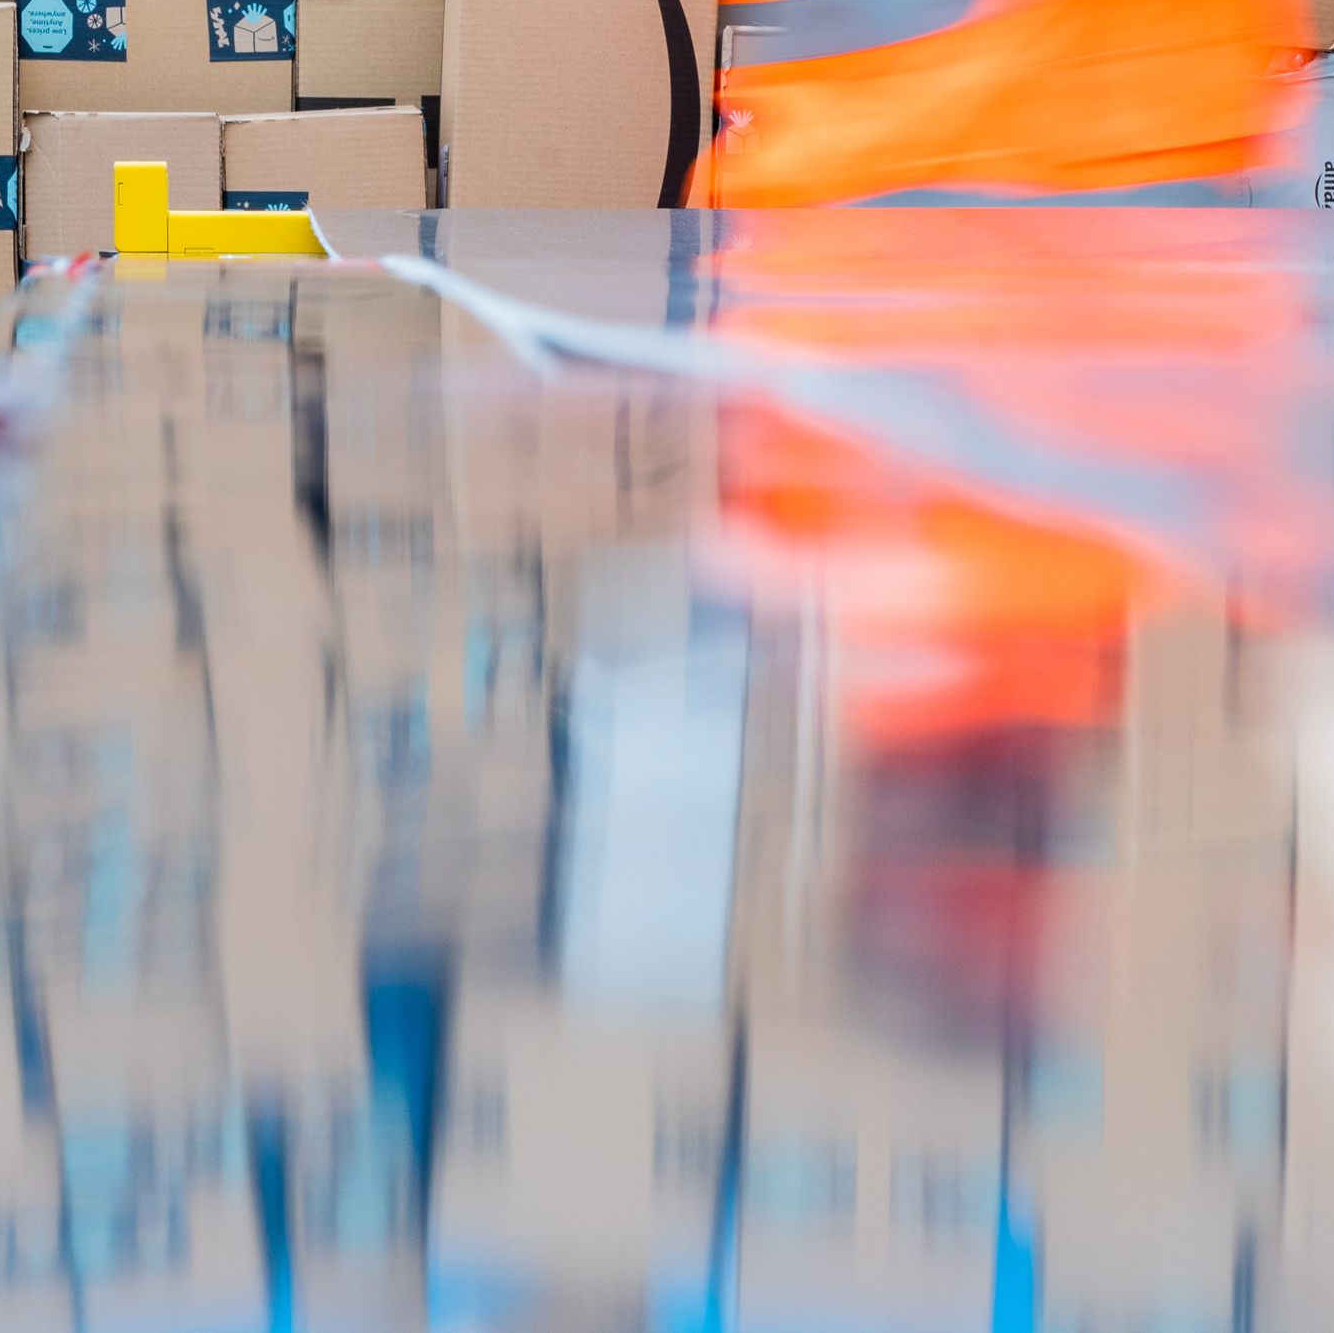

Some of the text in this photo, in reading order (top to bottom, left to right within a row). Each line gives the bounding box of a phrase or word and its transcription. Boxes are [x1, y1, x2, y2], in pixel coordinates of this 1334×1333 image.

[27, 10, 66, 18] anywhere.
[29, 17, 63, 27] Anytime,
[26, 26, 50, 35] prices.
